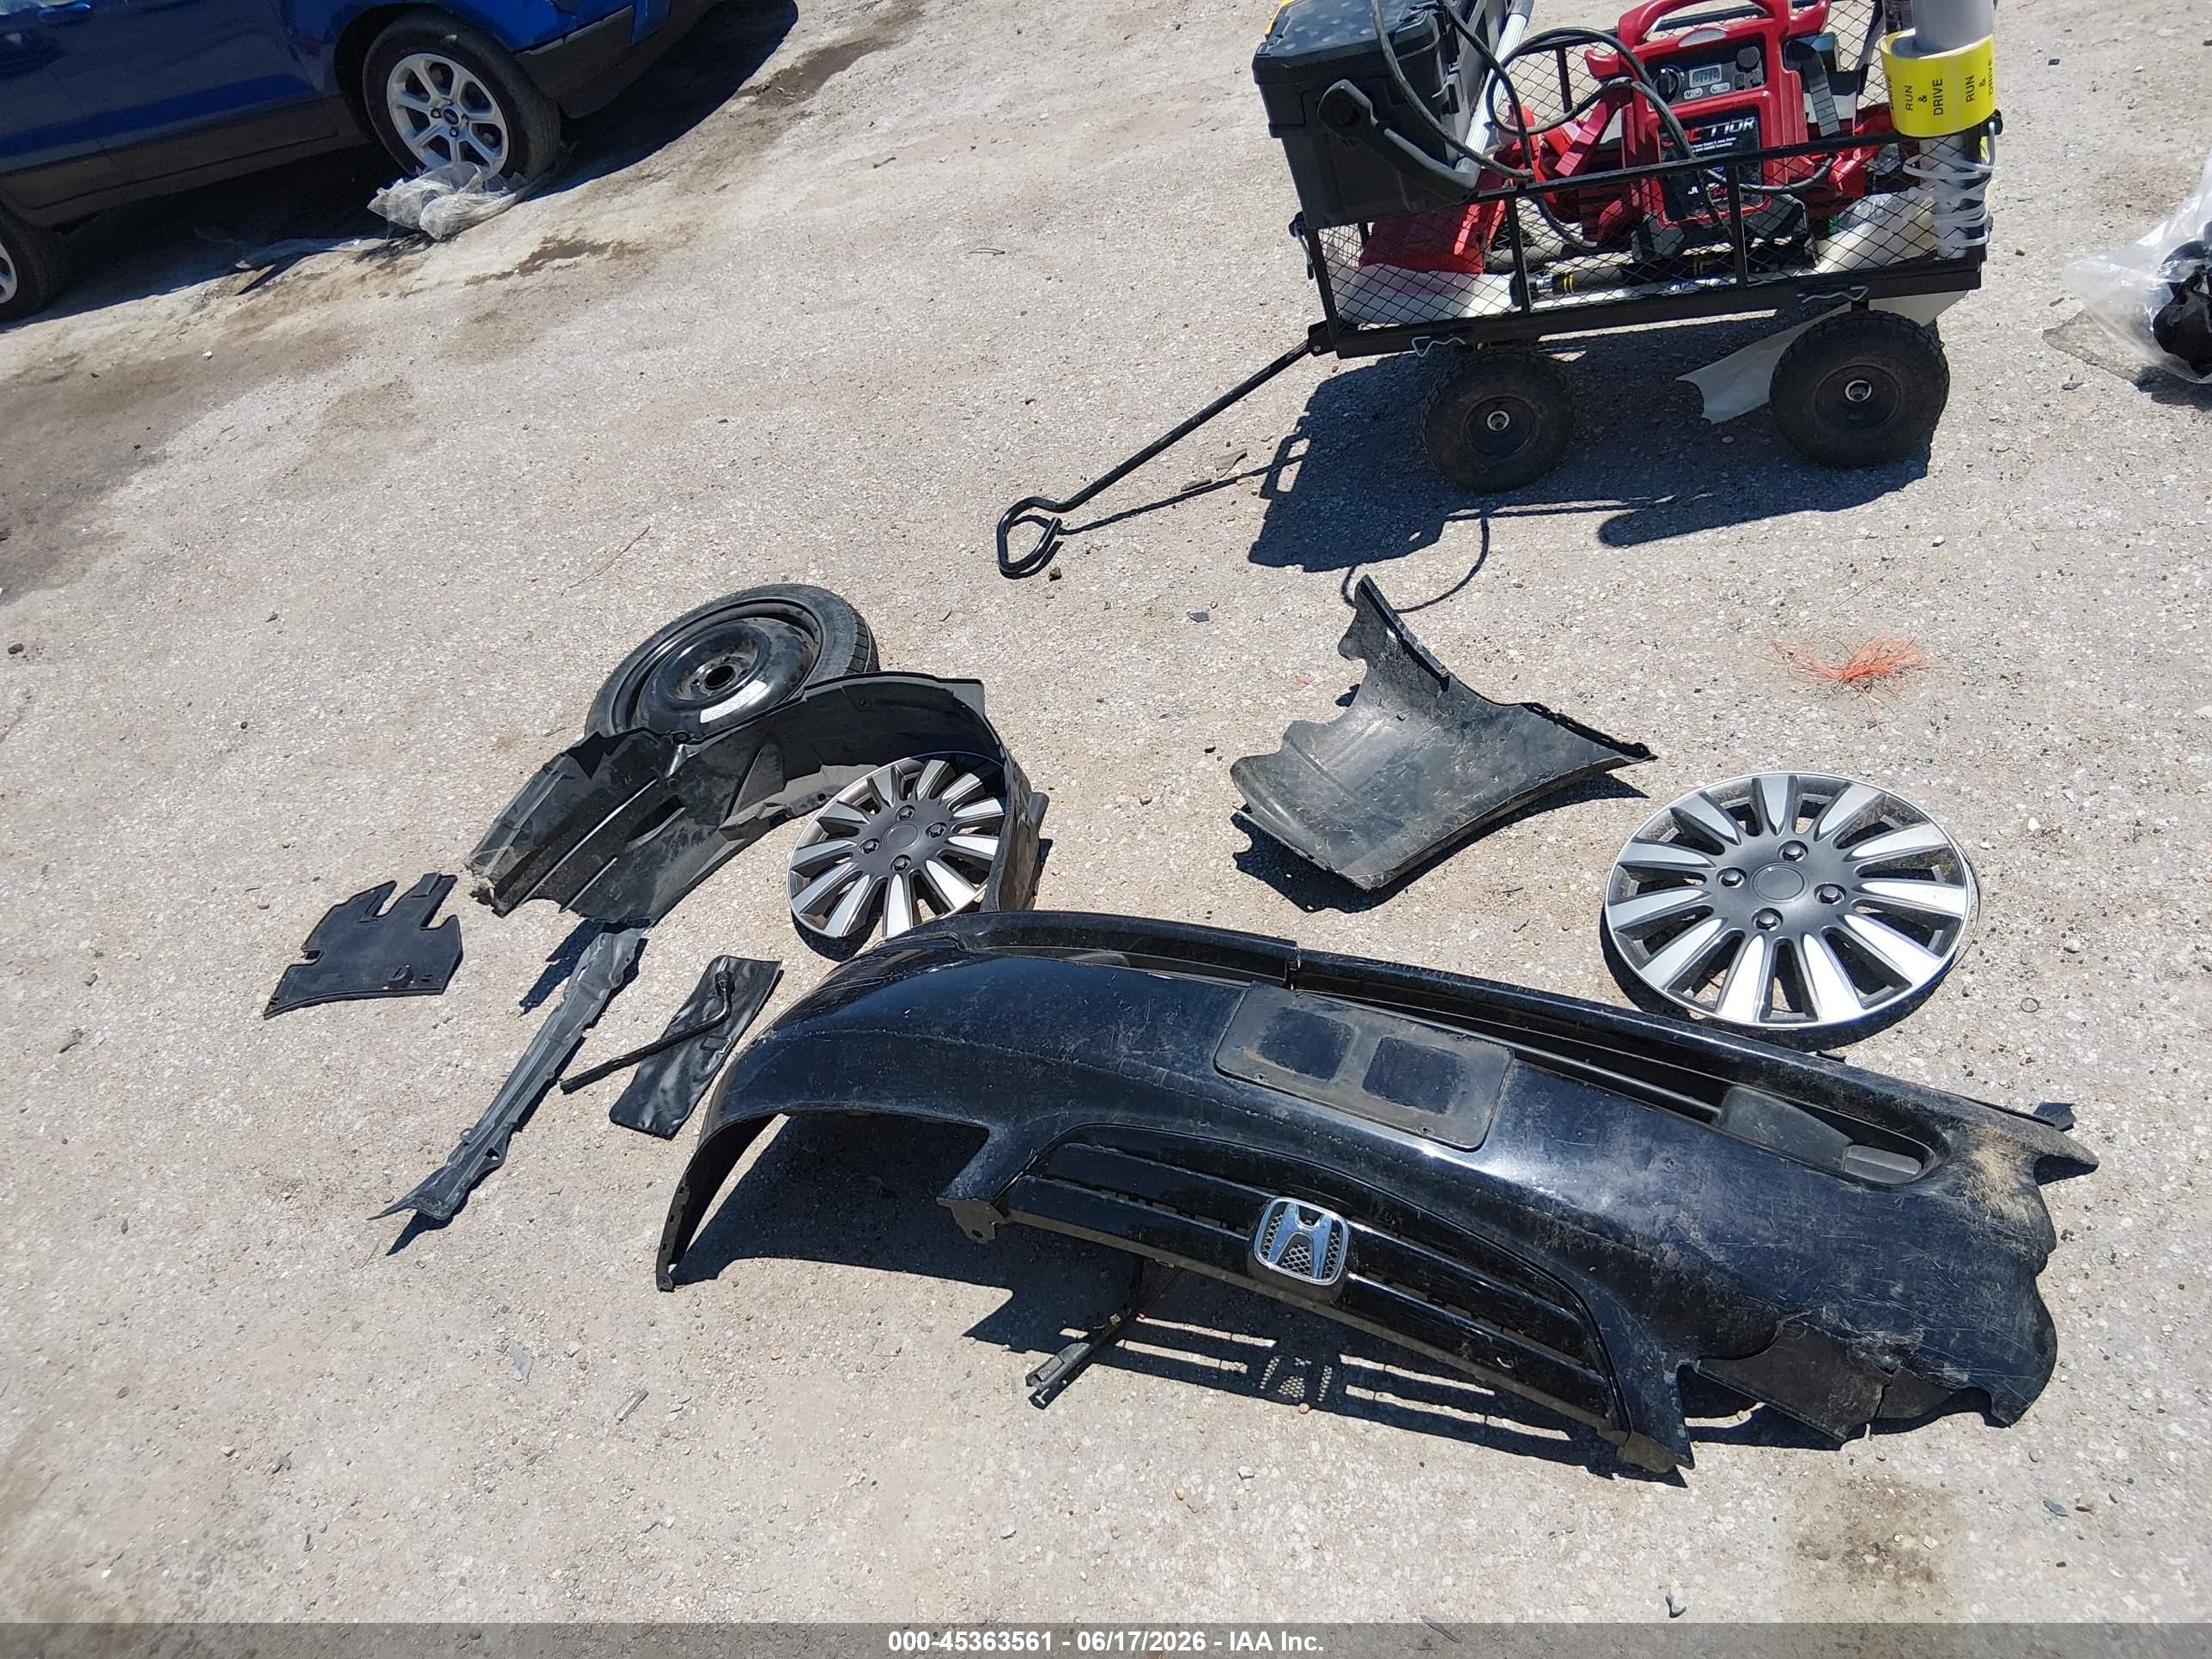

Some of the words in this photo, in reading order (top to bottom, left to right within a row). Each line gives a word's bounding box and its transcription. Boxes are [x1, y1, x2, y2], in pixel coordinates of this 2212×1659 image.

[1965, 75, 1975, 103] RUN
[1978, 77, 1986, 88] &
[1904, 85, 1914, 111] RUN
[1917, 94, 1928, 103] &
[1932, 78, 1944, 116] DRIVE
